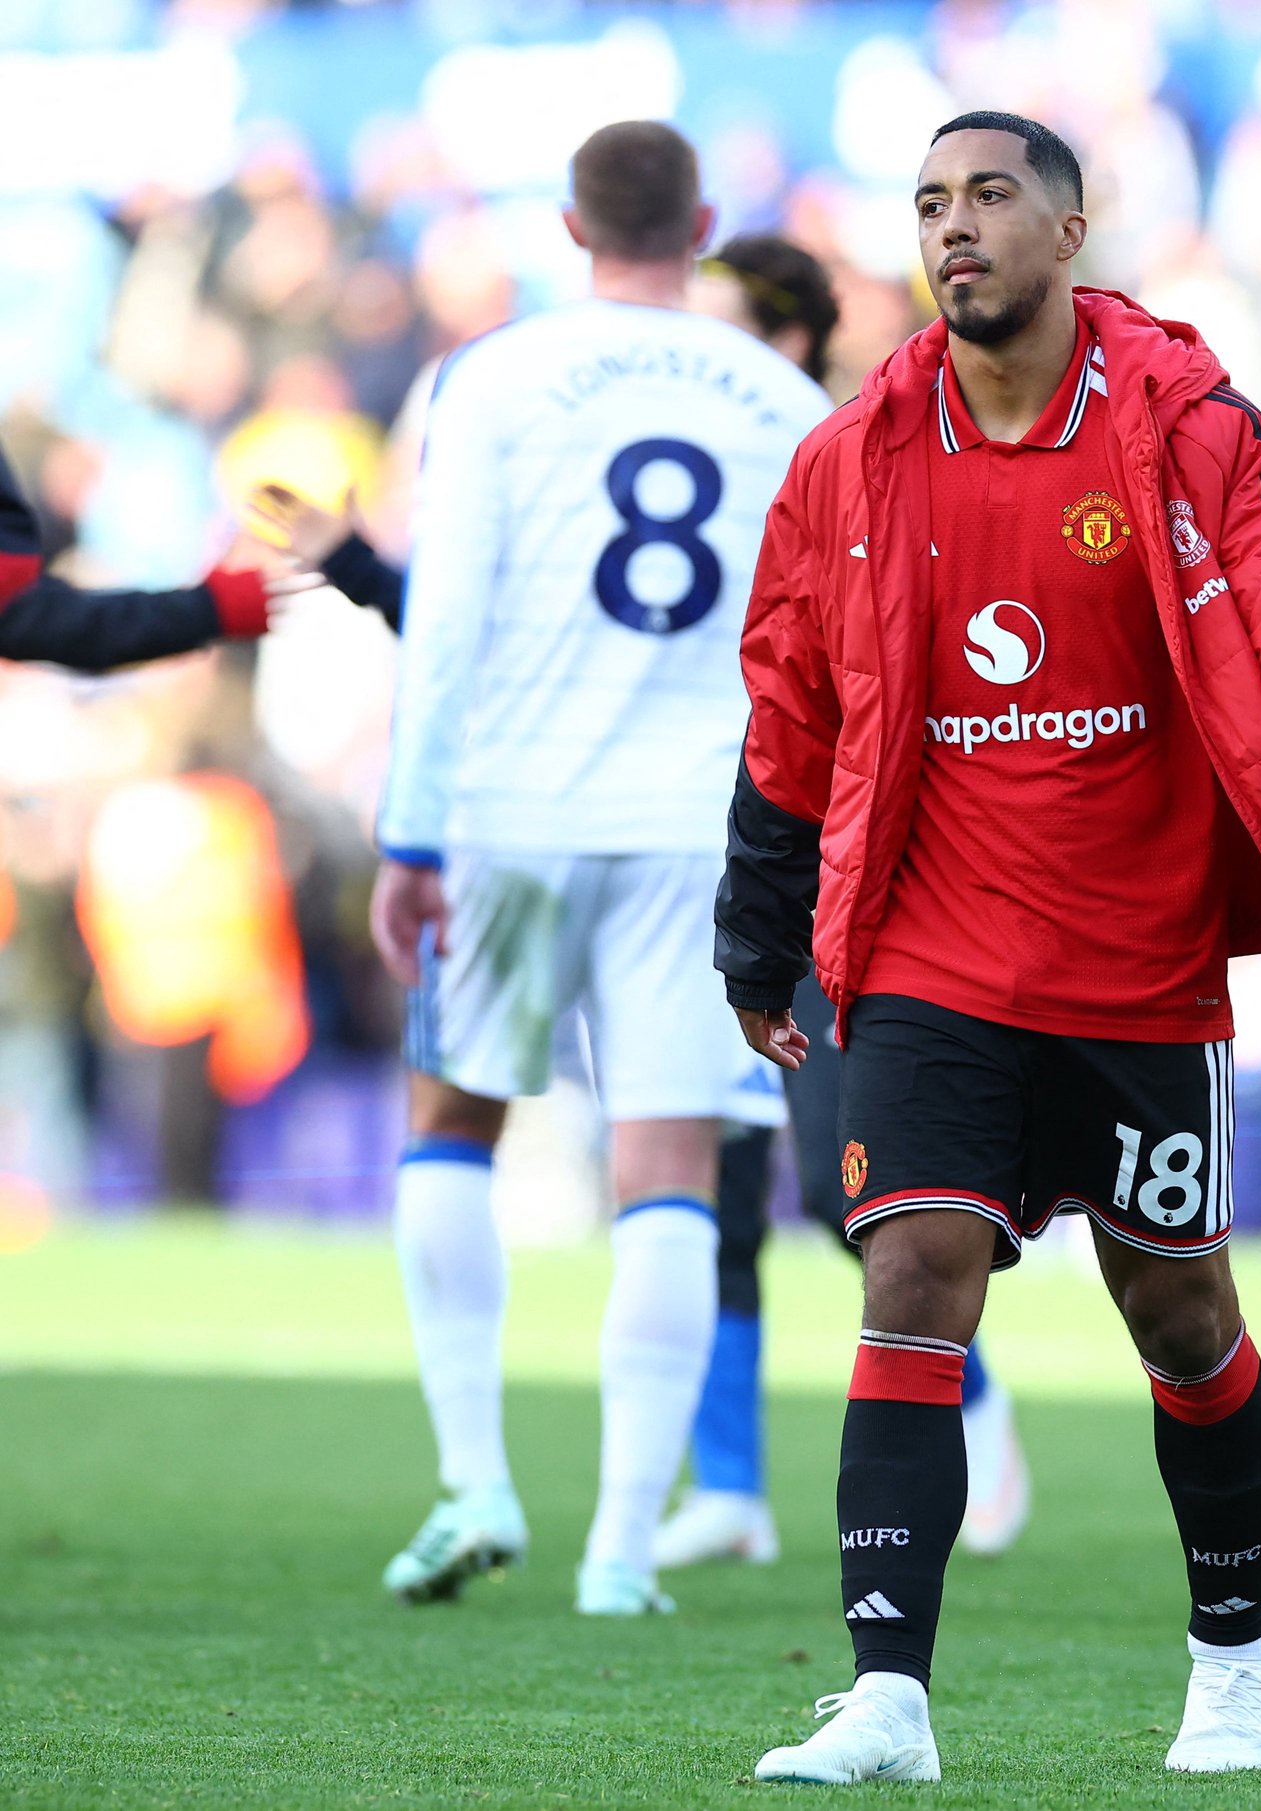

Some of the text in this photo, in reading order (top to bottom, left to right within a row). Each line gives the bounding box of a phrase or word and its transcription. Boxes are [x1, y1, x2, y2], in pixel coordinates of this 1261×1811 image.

[1068, 497, 1126, 520] MANCHESTER
[595, 438, 723, 635] 8
[1077, 546, 1118, 560] UNITED
[1180, 540, 1209, 566] UNITED
[1113, 1122, 1203, 1227] 18
[841, 1527, 910, 1551] MUFC
[1191, 1544, 1261, 1568] MUFC
